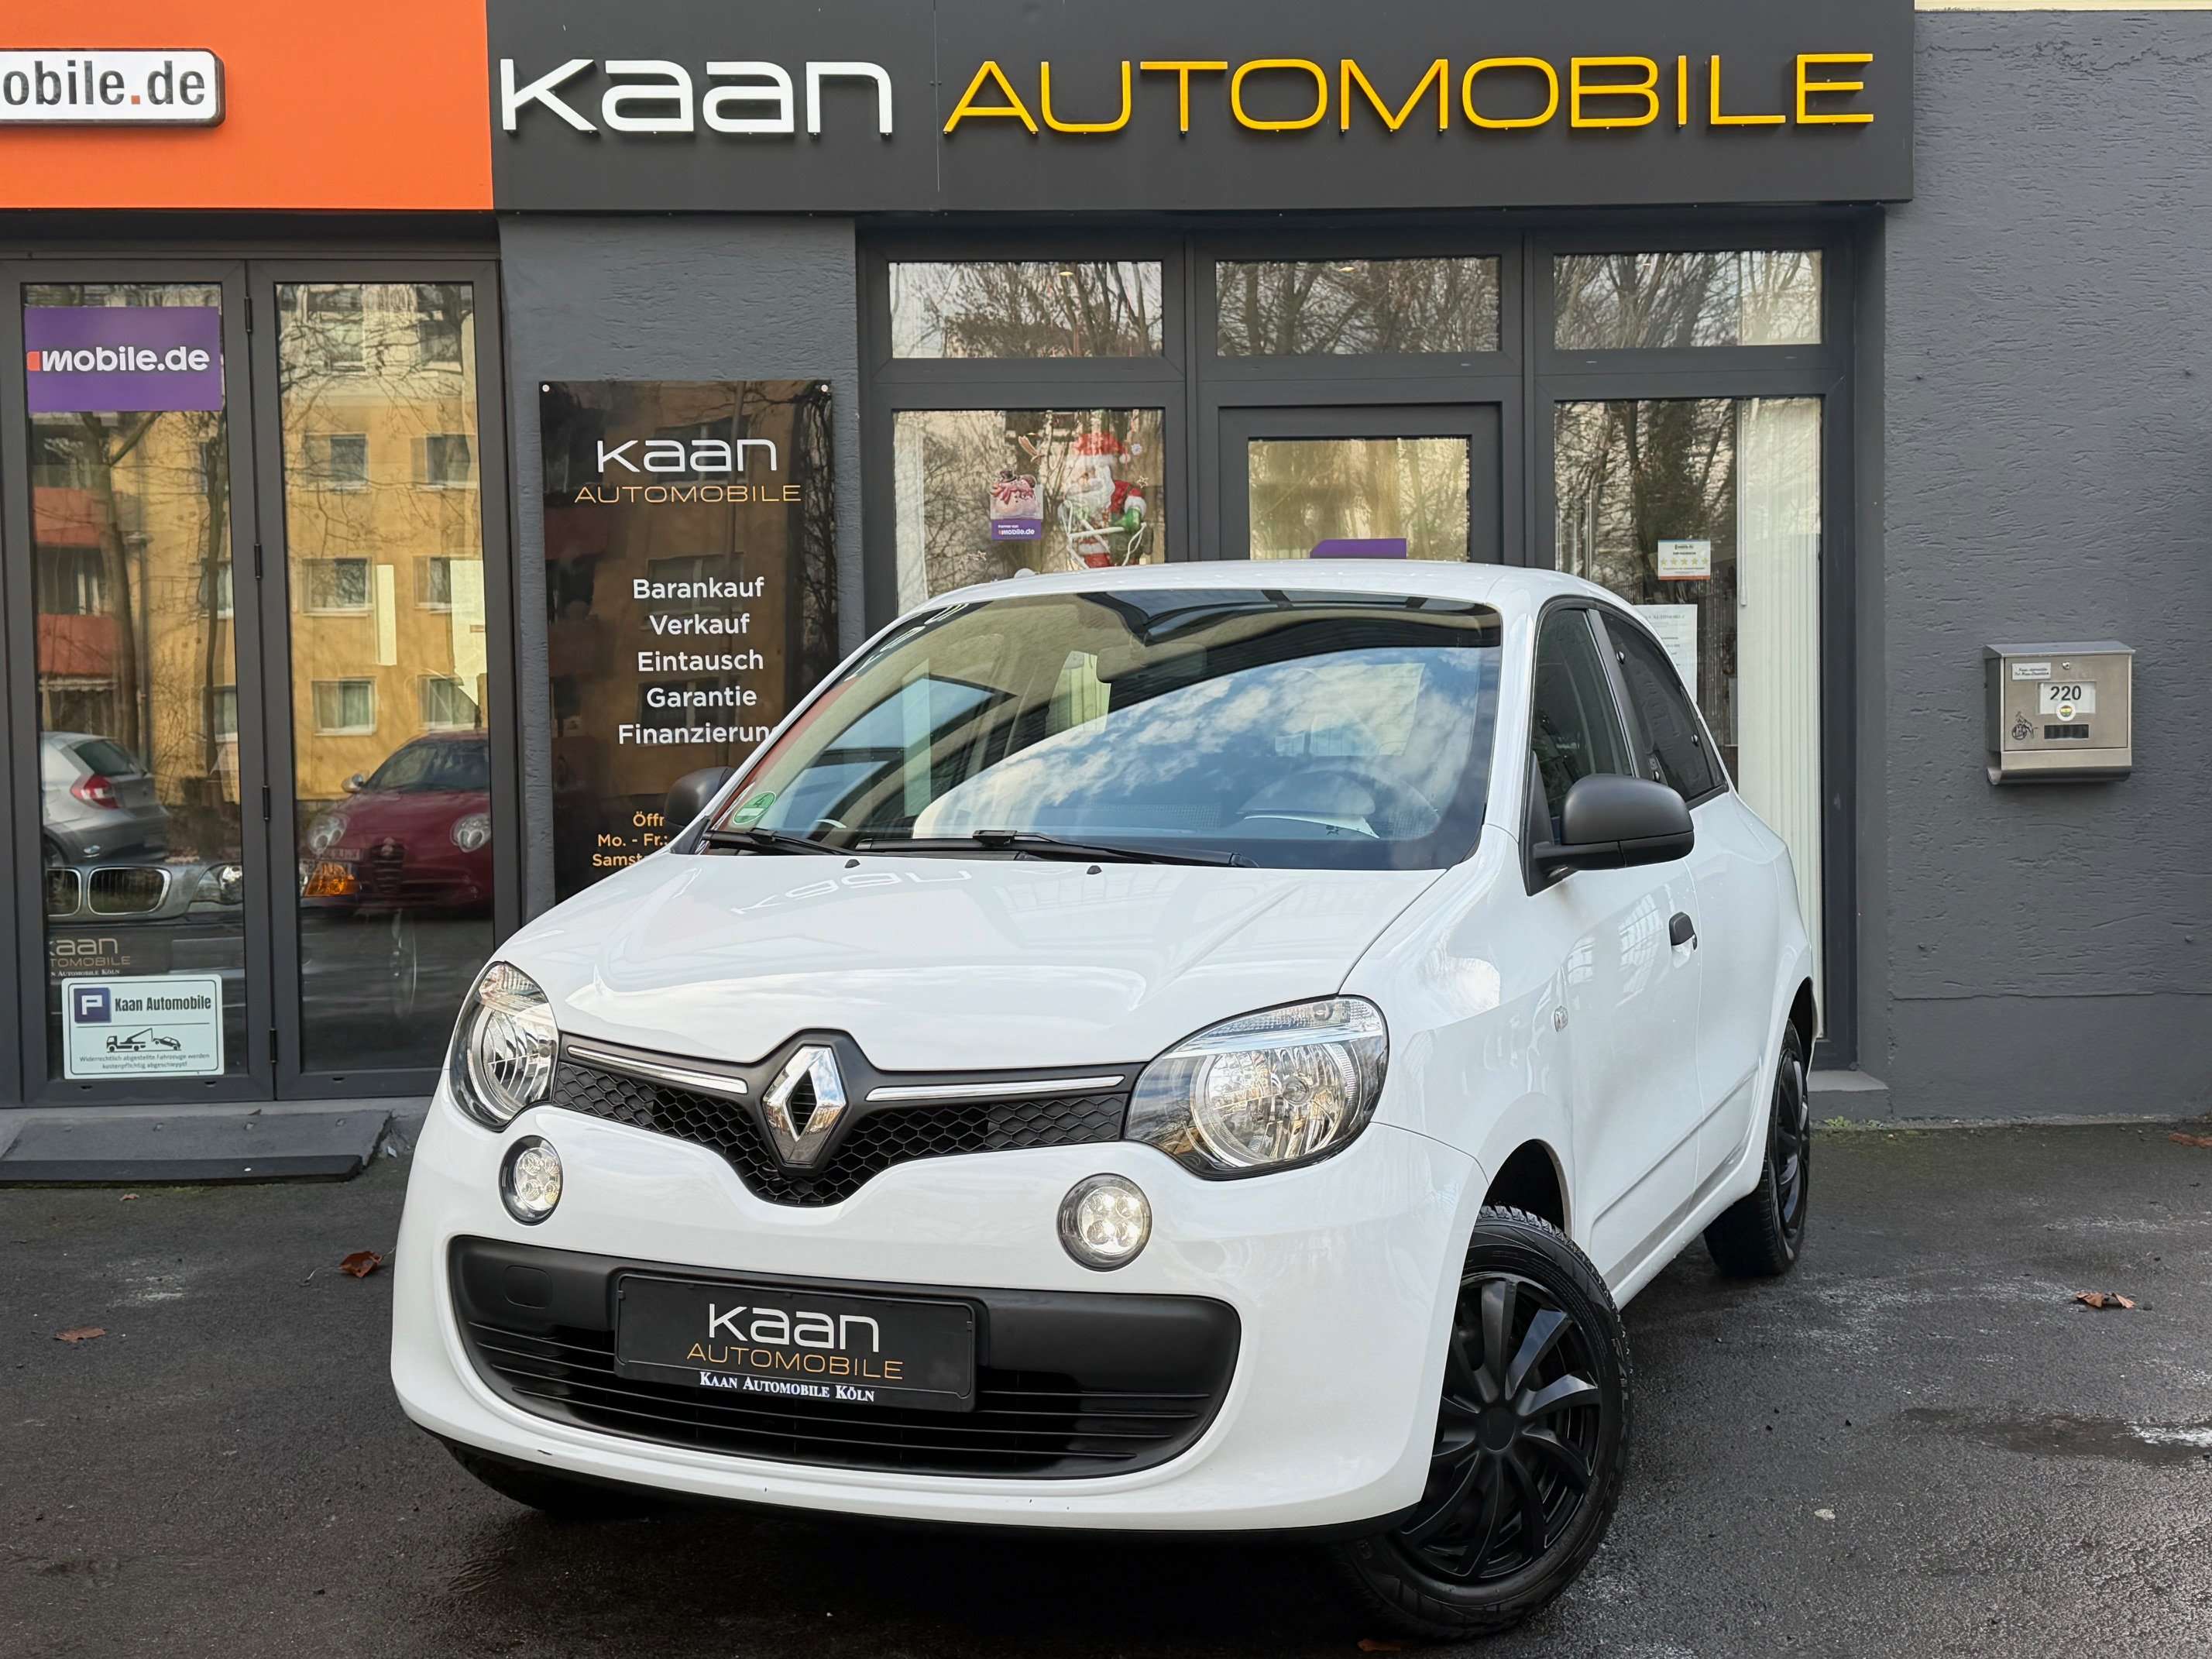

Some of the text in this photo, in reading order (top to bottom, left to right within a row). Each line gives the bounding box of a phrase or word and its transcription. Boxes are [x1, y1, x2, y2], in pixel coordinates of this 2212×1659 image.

[943, 53, 1874, 133] AUTOMOBILE
[43, 345, 211, 372] mobile.de
[574, 485, 802, 504] AUTOMOBILE
[632, 577, 765, 600] Barankauf
[649, 613, 750, 636] Verkauf
[637, 649, 764, 672] Eintausch
[646, 685, 758, 708] Garantie
[2049, 685, 2082, 701] 220
[753, 793, 769, 808] 4
[597, 833, 627, 847] Mo.
[81, 994, 103, 1015] P
[115, 994, 211, 1012] Kaan Automobile
[686, 1342, 904, 1379] AUTOMOBILE
